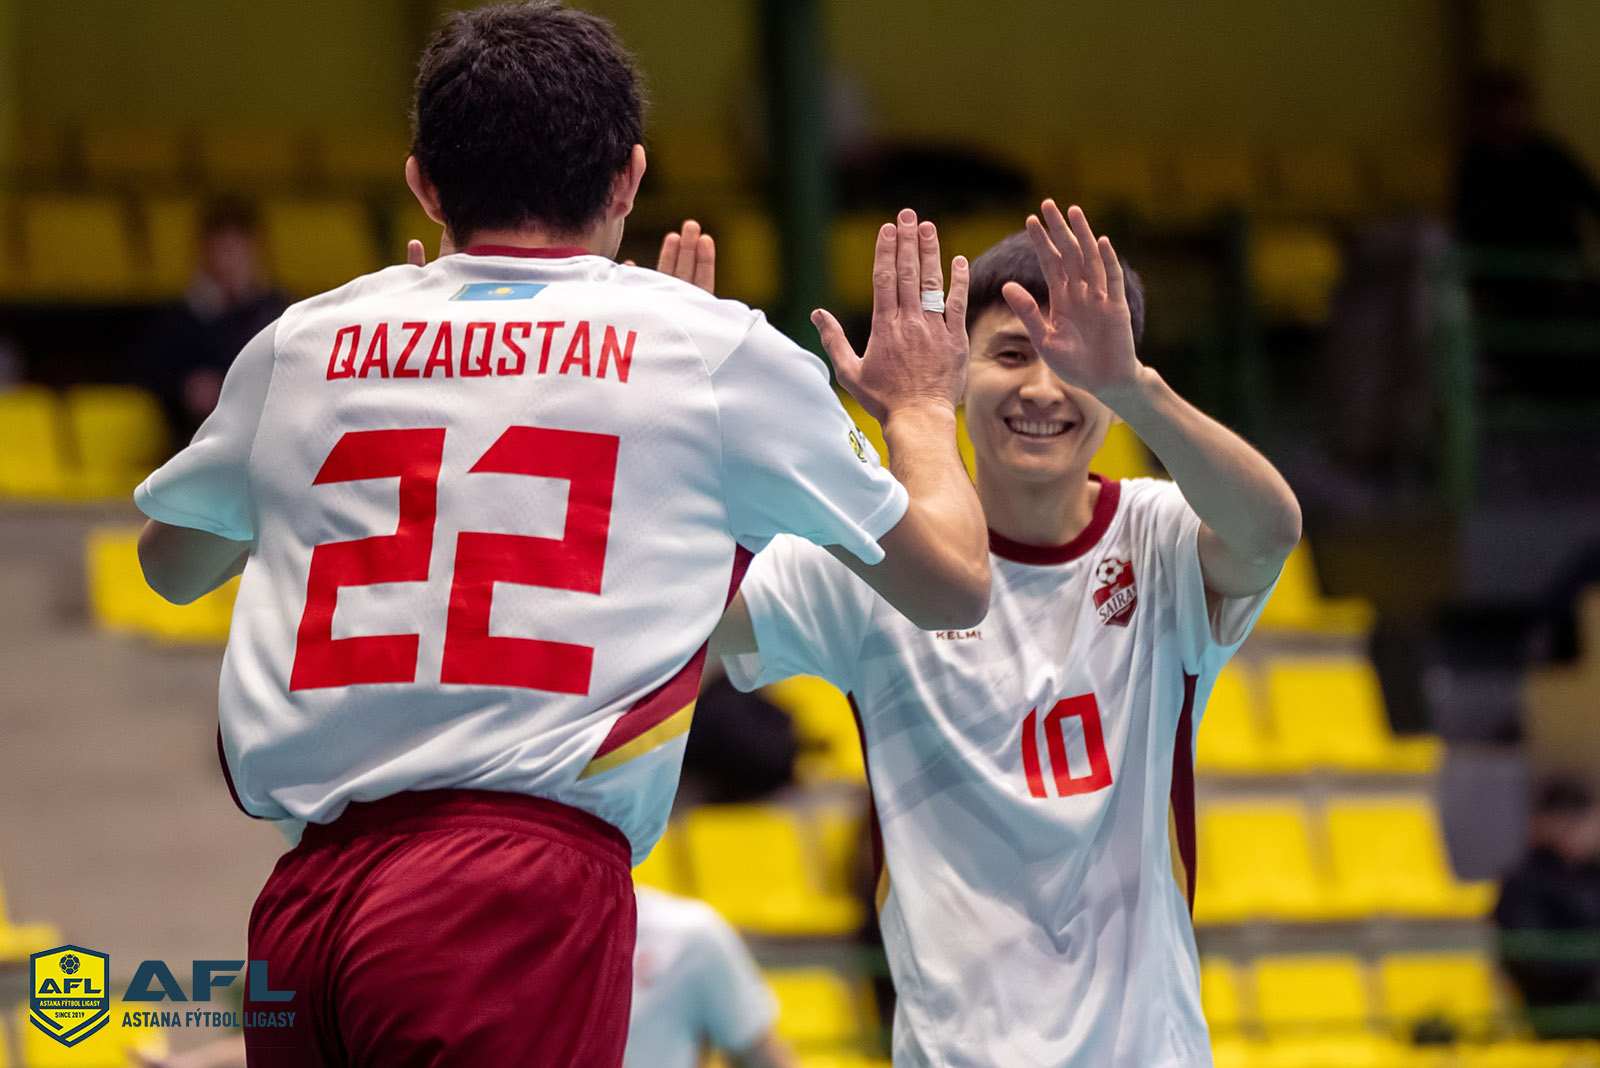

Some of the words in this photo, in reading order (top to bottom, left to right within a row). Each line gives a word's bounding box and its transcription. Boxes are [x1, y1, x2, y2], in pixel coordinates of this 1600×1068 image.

[326, 321, 637, 384] QAZAQSTAN
[289, 425, 620, 697] 22
[1021, 691, 1113, 799] 10
